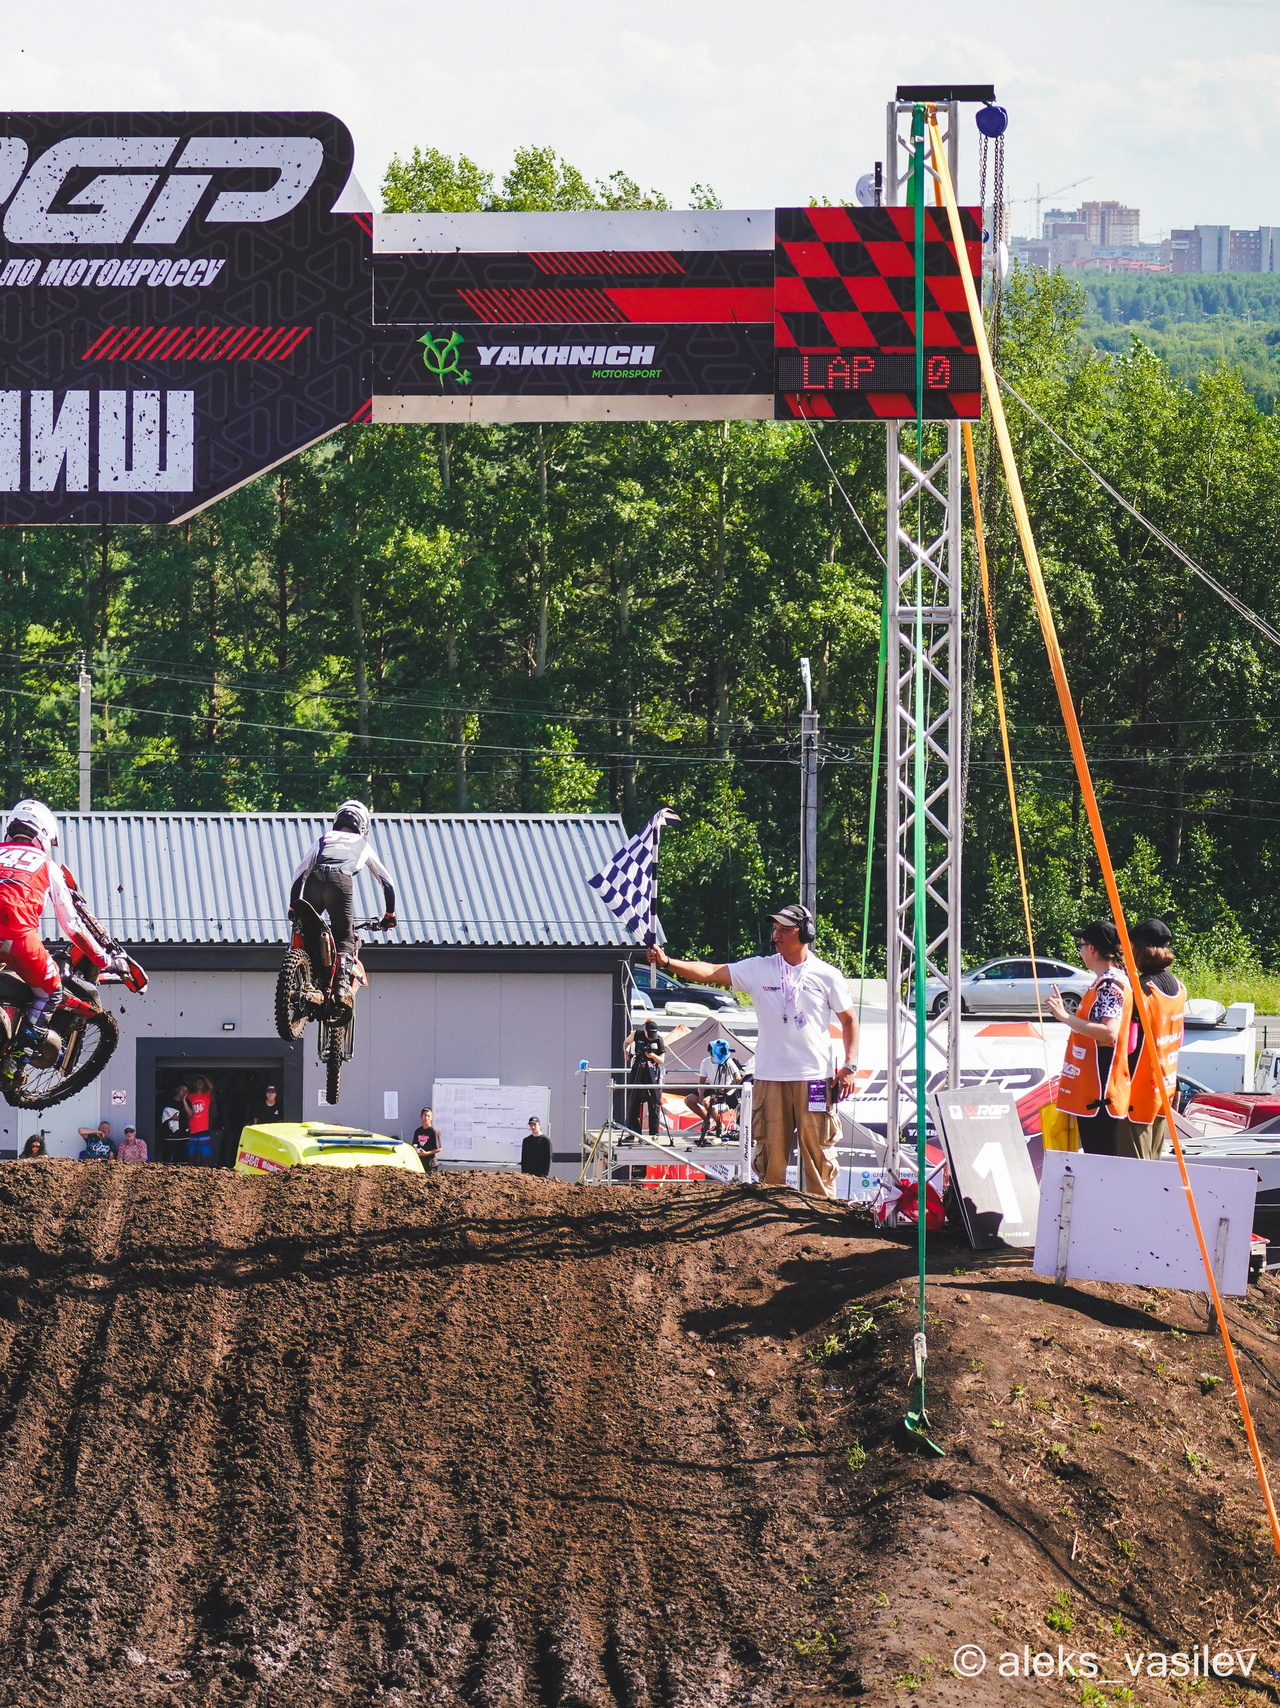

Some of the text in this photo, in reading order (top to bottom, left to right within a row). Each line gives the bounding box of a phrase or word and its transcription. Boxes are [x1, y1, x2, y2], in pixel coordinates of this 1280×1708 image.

[39, 258, 226, 288] МОТОКРОССУ
[476, 345, 656, 366] YAKHNICH
[591, 369, 663, 379] MOTORSPORT
[803, 355, 951, 389] LAP 0
[972, 1142, 1023, 1223] 1
